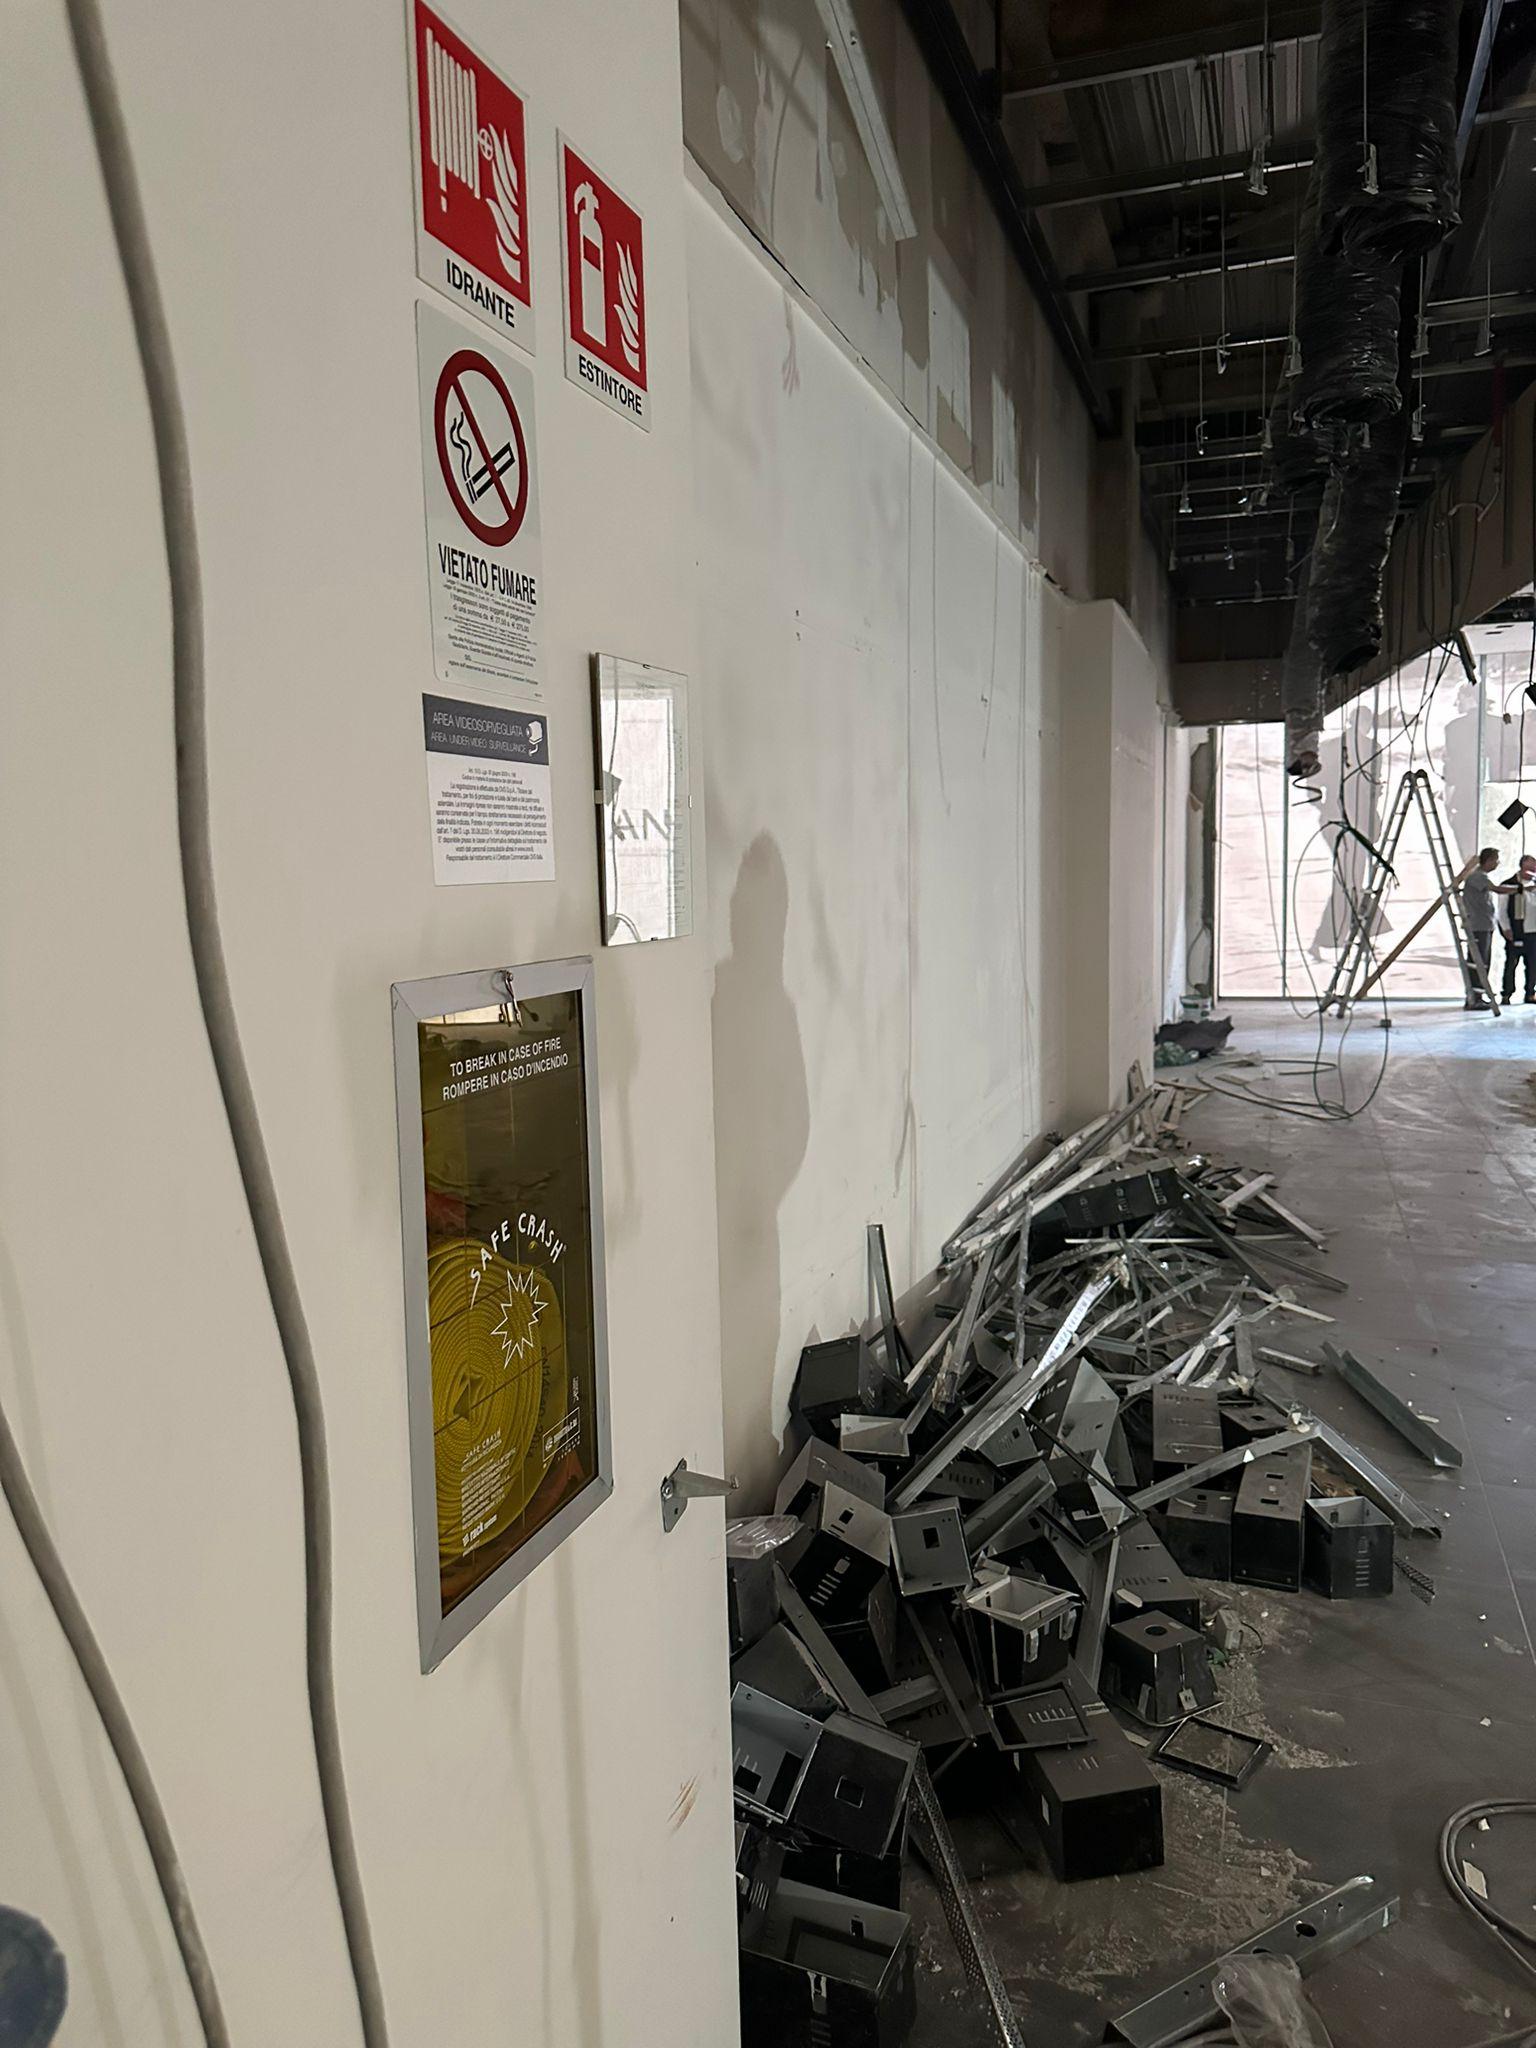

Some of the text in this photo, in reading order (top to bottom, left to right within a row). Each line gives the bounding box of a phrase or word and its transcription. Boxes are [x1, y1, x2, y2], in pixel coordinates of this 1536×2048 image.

[446, 258, 515, 329] IDRANTE
[579, 354, 643, 416] ESTINTORE
[438, 543, 489, 589] VIETATO
[491, 563, 537, 606] FUMARE
[430, 731, 448, 743] AREA
[432, 712, 454, 727] AREA
[442, 1053, 569, 1101] ROMPERE IN CASO D'INCENDIO
[450, 1037, 561, 1078] TO BREAK IN CASE OF FIRE
[470, 1220, 511, 1311] SAFE
